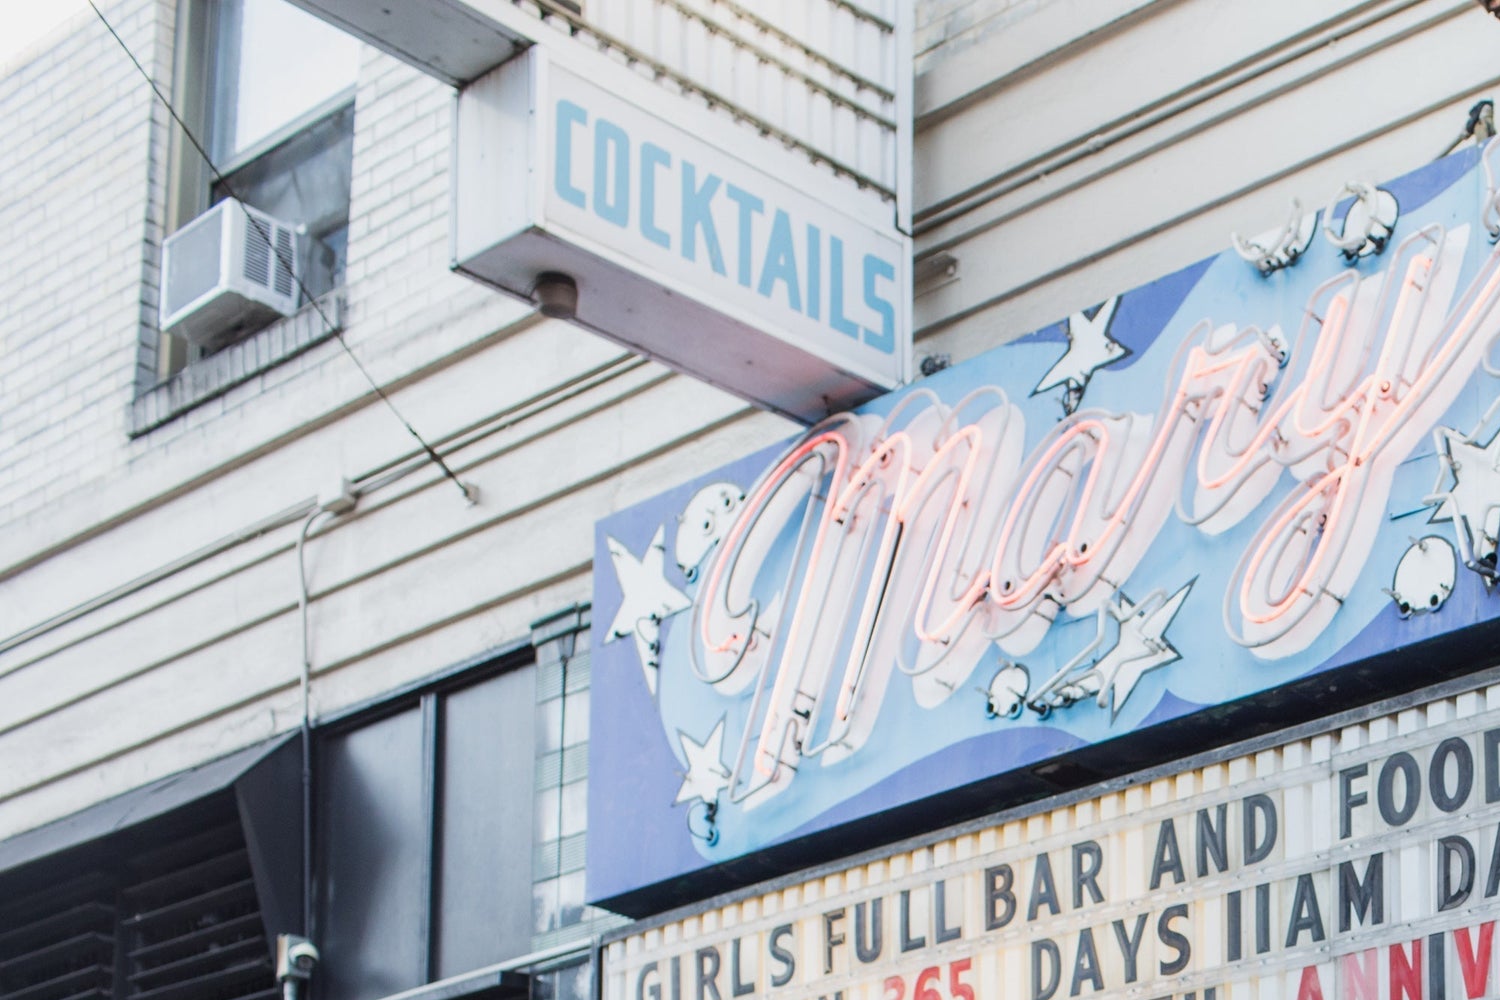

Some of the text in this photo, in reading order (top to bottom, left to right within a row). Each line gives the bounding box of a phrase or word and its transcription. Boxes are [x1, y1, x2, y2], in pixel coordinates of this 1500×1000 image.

[554, 98, 895, 356] COCKTAILS
[823, 880, 962, 975] FULL
[985, 846, 1105, 932] BAR
[1150, 793, 1279, 891] AND
